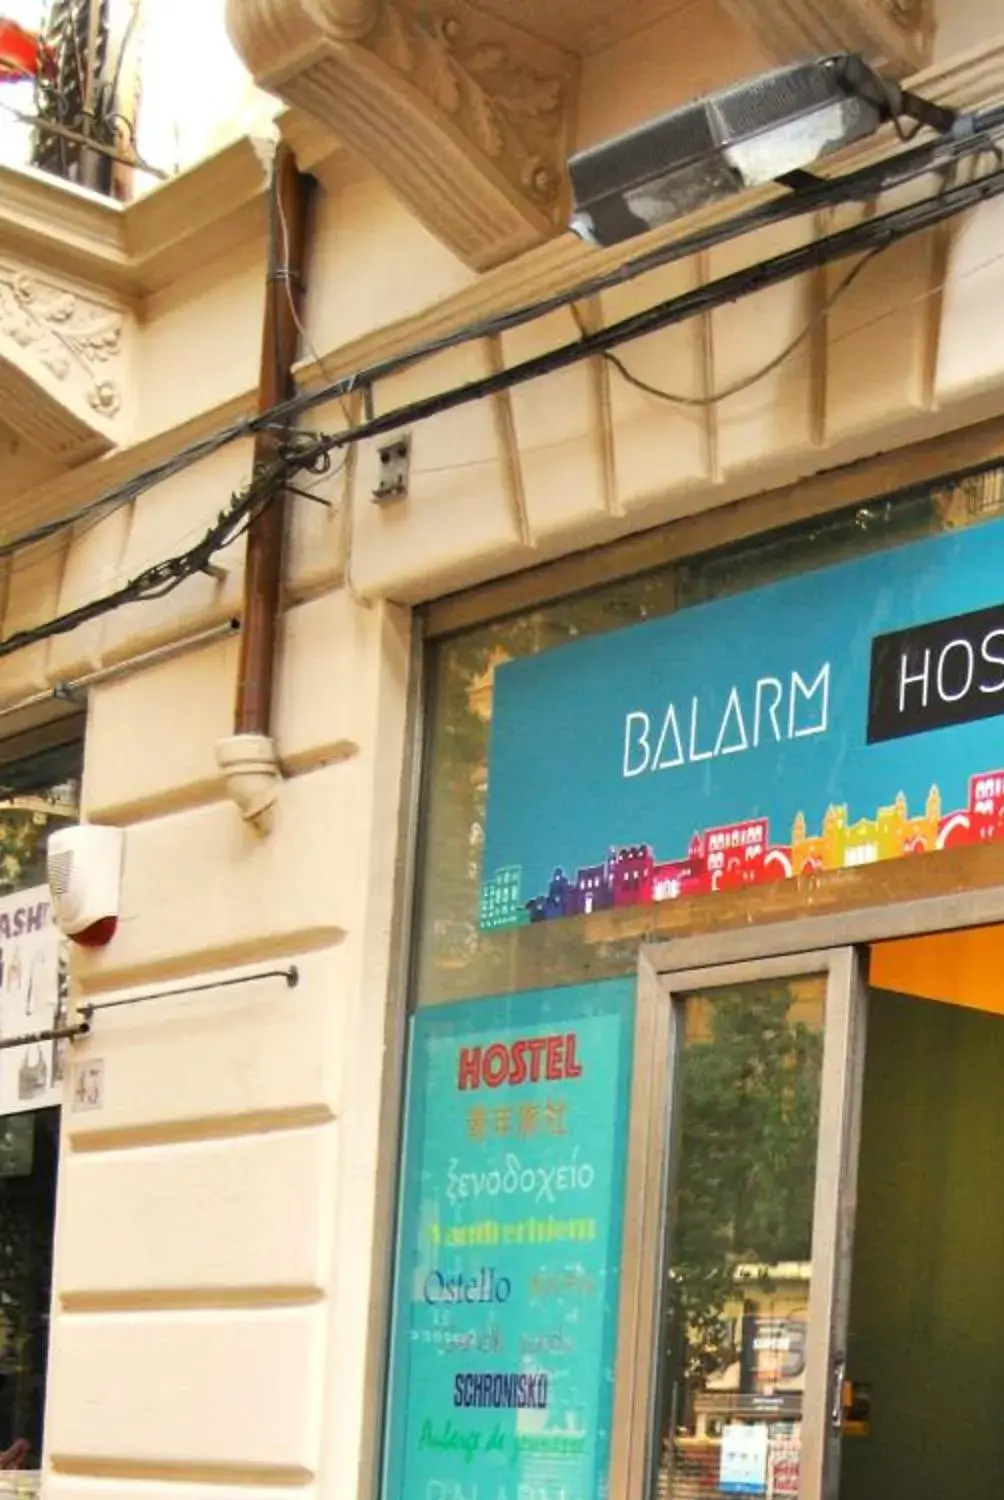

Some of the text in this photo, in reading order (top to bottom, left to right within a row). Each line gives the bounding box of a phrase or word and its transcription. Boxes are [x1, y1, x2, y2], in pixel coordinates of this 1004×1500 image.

[622, 662, 831, 778] BALARM
[457, 1032, 582, 1091] HOSTEL
[453, 1372, 549, 1409] SCHRONISKO
